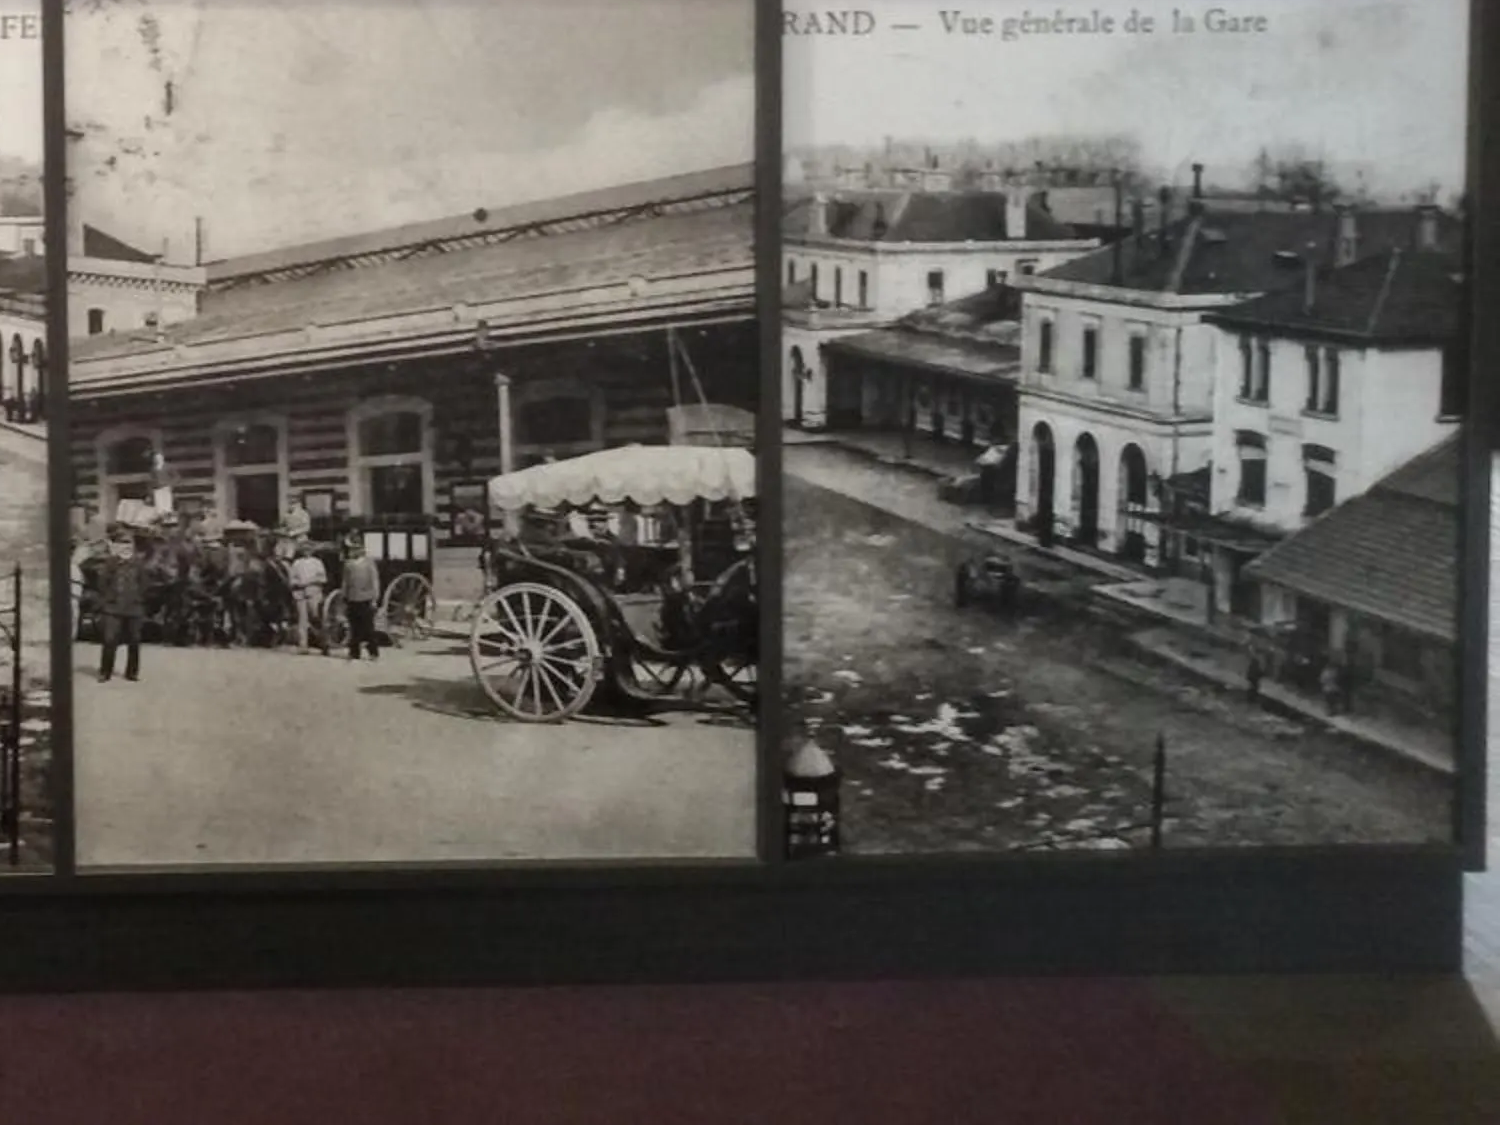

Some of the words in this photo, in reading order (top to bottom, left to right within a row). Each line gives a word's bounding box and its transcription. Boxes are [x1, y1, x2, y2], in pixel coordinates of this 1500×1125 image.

[938, 9, 994, 34] Vue
[1000, 9, 1116, 42] générale
[1123, 8, 1155, 33] de
[1172, 7, 1197, 33] la
[1204, 7, 1270, 33] Gare
